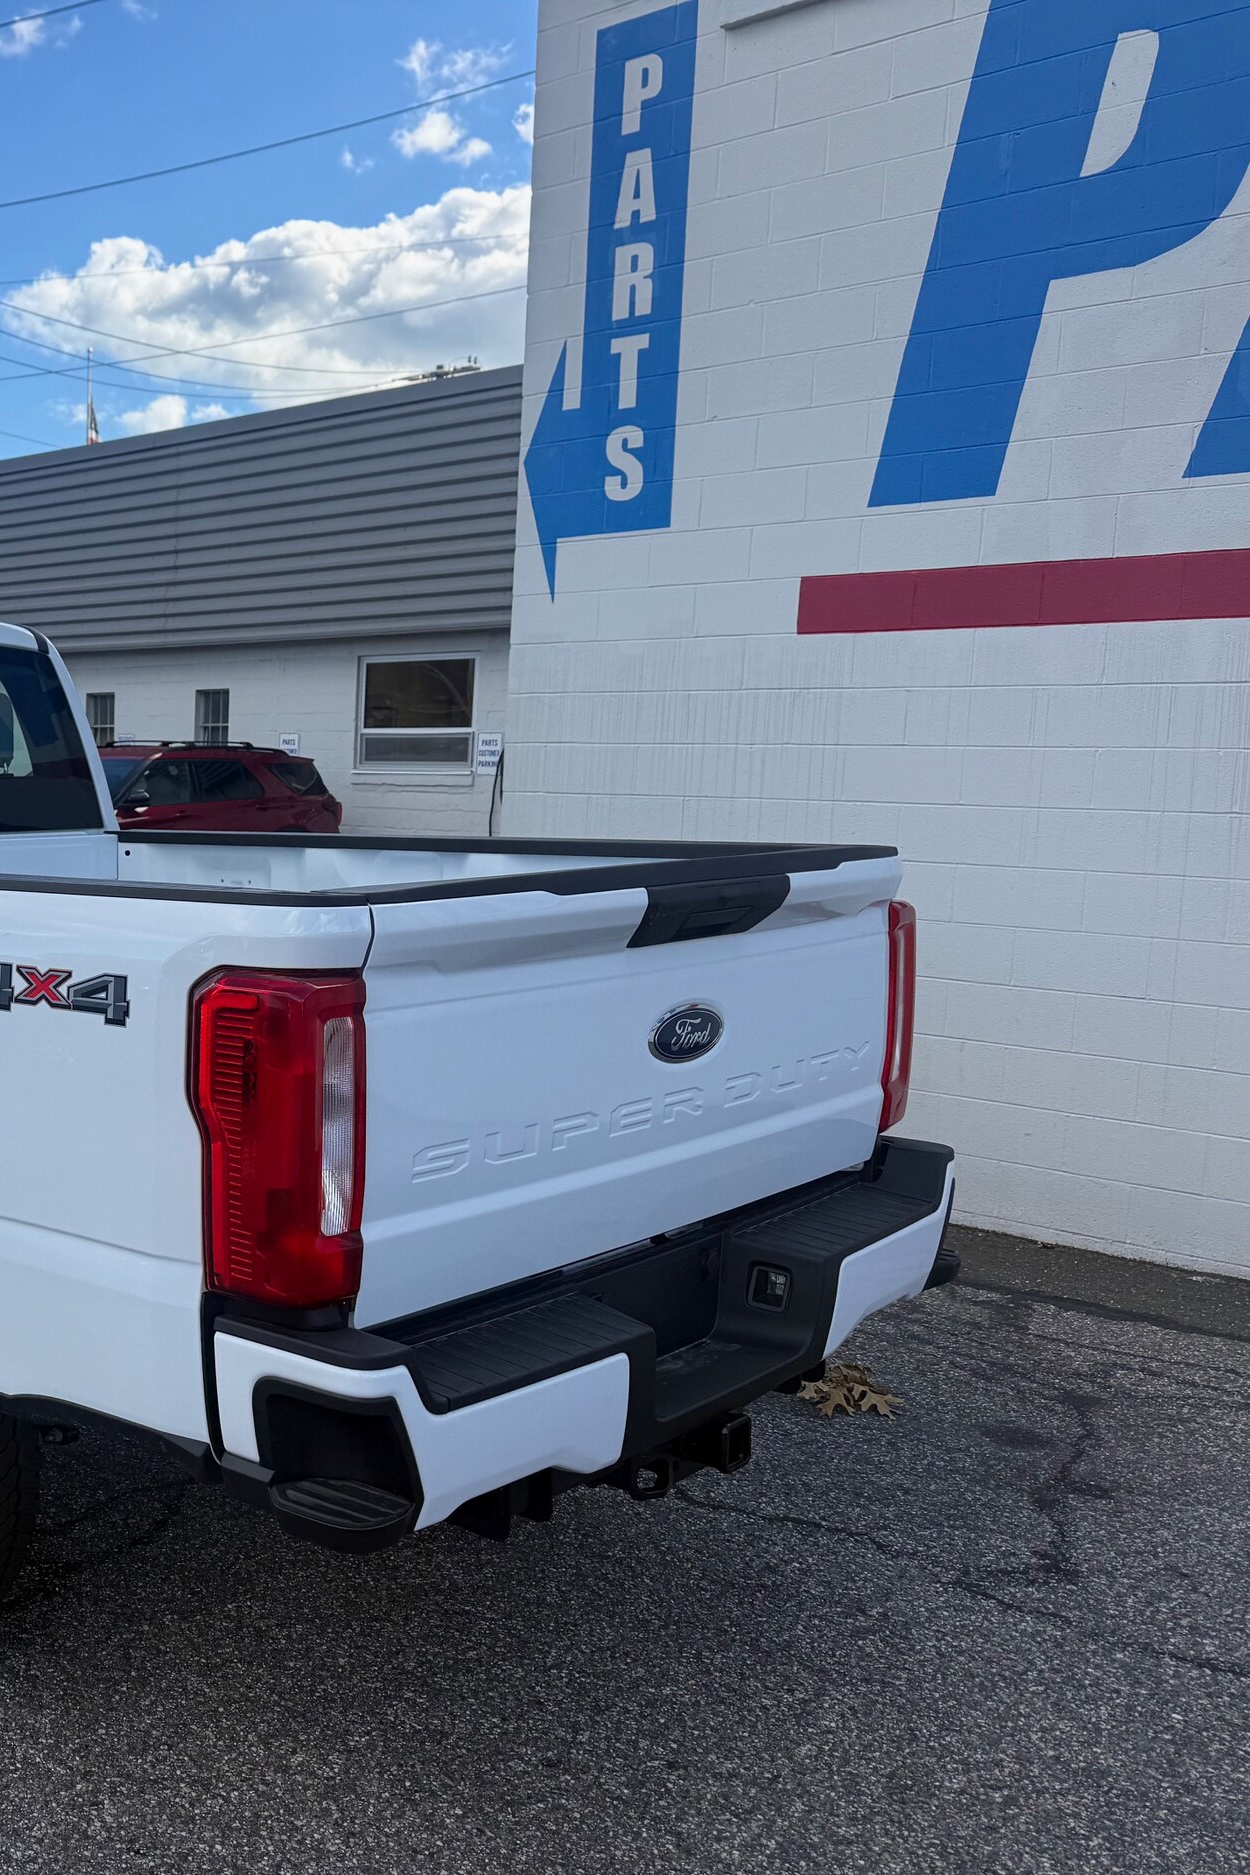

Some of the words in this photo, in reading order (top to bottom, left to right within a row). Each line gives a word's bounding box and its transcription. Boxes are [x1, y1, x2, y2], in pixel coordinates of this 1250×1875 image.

[604, 53, 664, 503] PARTS
[867, 0, 1250, 507] P
[282, 738, 296, 746] PARTS
[481, 739, 498, 747] PARTS
[671, 1017, 711, 1051] Ford
[411, 1086, 703, 1184] SUPER
[723, 1040, 870, 1108] DUTY
